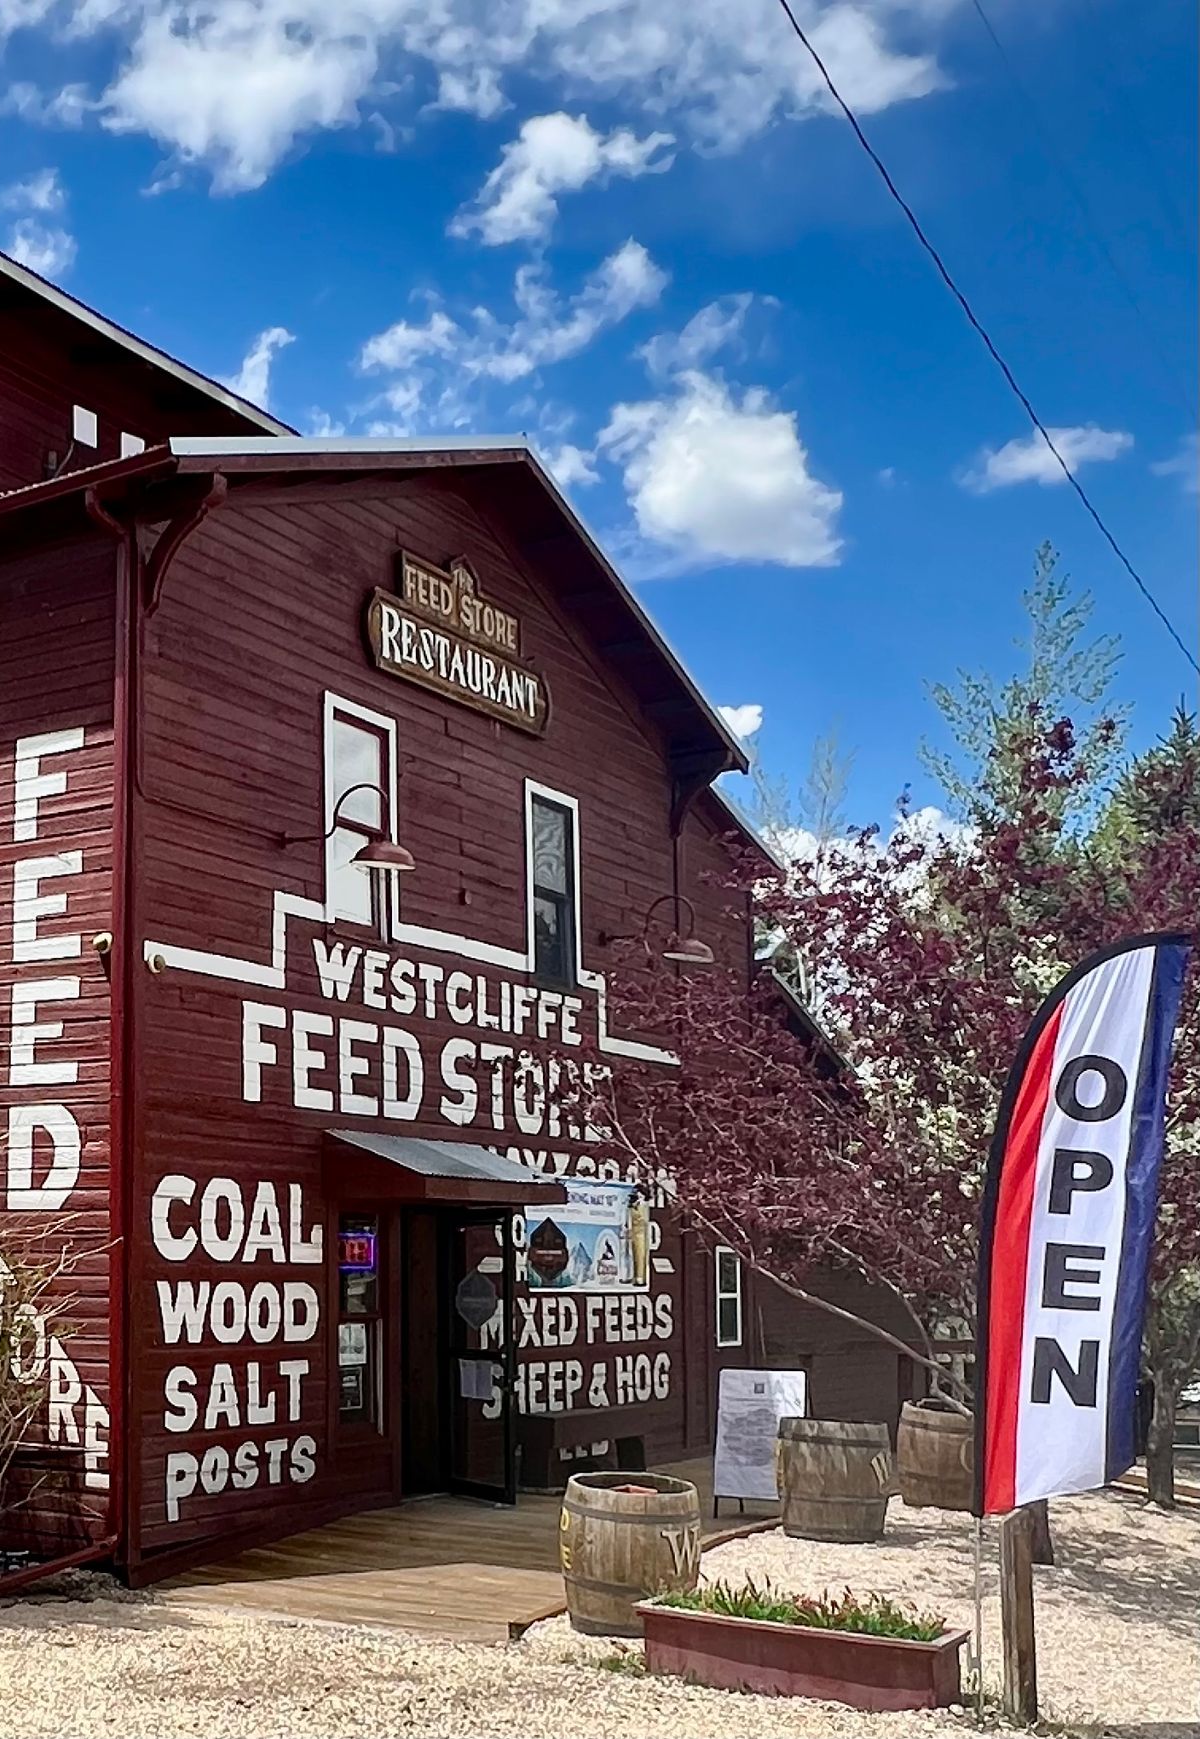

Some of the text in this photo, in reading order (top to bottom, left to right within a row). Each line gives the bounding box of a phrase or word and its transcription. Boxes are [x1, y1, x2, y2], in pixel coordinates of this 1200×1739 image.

[404, 563, 519, 651] FEED STORE
[380, 602, 539, 718] RESTAURANT
[7, 727, 85, 1211] FEED
[312, 938, 583, 1046] WESTCLIFFE
[242, 1000, 425, 1121] FEED
[151, 1174, 324, 1264] COAL
[1029, 1054, 1128, 1409] OPEN
[156, 1280, 321, 1344] WOOD
[480, 1293, 674, 1350] MXED FEEDS
[164, 1359, 310, 1432] SALT
[588, 1361, 610, 1408] &
[615, 1351, 672, 1405] HOG
[166, 1435, 317, 1523] POSTS
